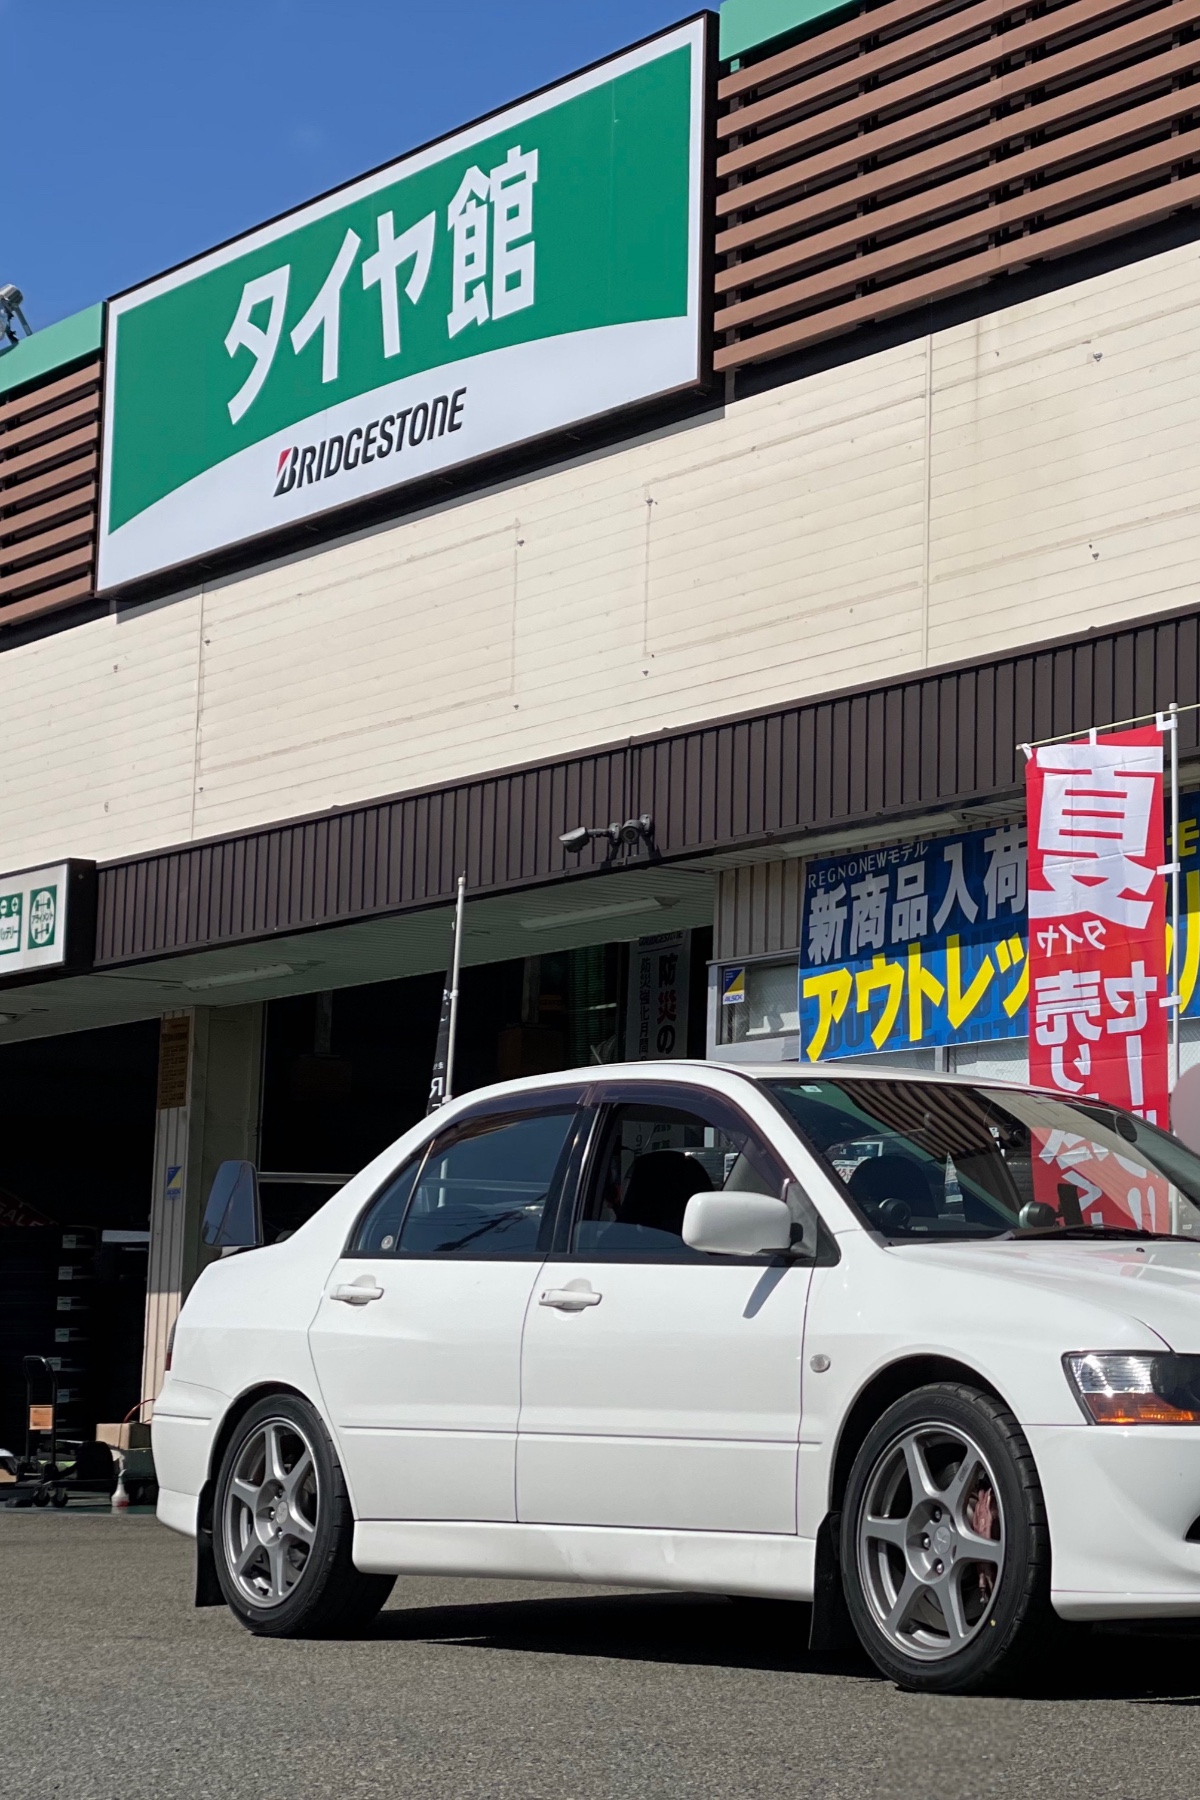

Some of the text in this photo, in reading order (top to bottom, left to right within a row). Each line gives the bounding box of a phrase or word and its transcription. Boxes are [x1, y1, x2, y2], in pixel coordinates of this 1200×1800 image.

[224, 145, 538, 426] タイヤ館
[273, 387, 467, 497] BRIDGESTONE
[808, 824, 1028, 966] 新商品入荷
